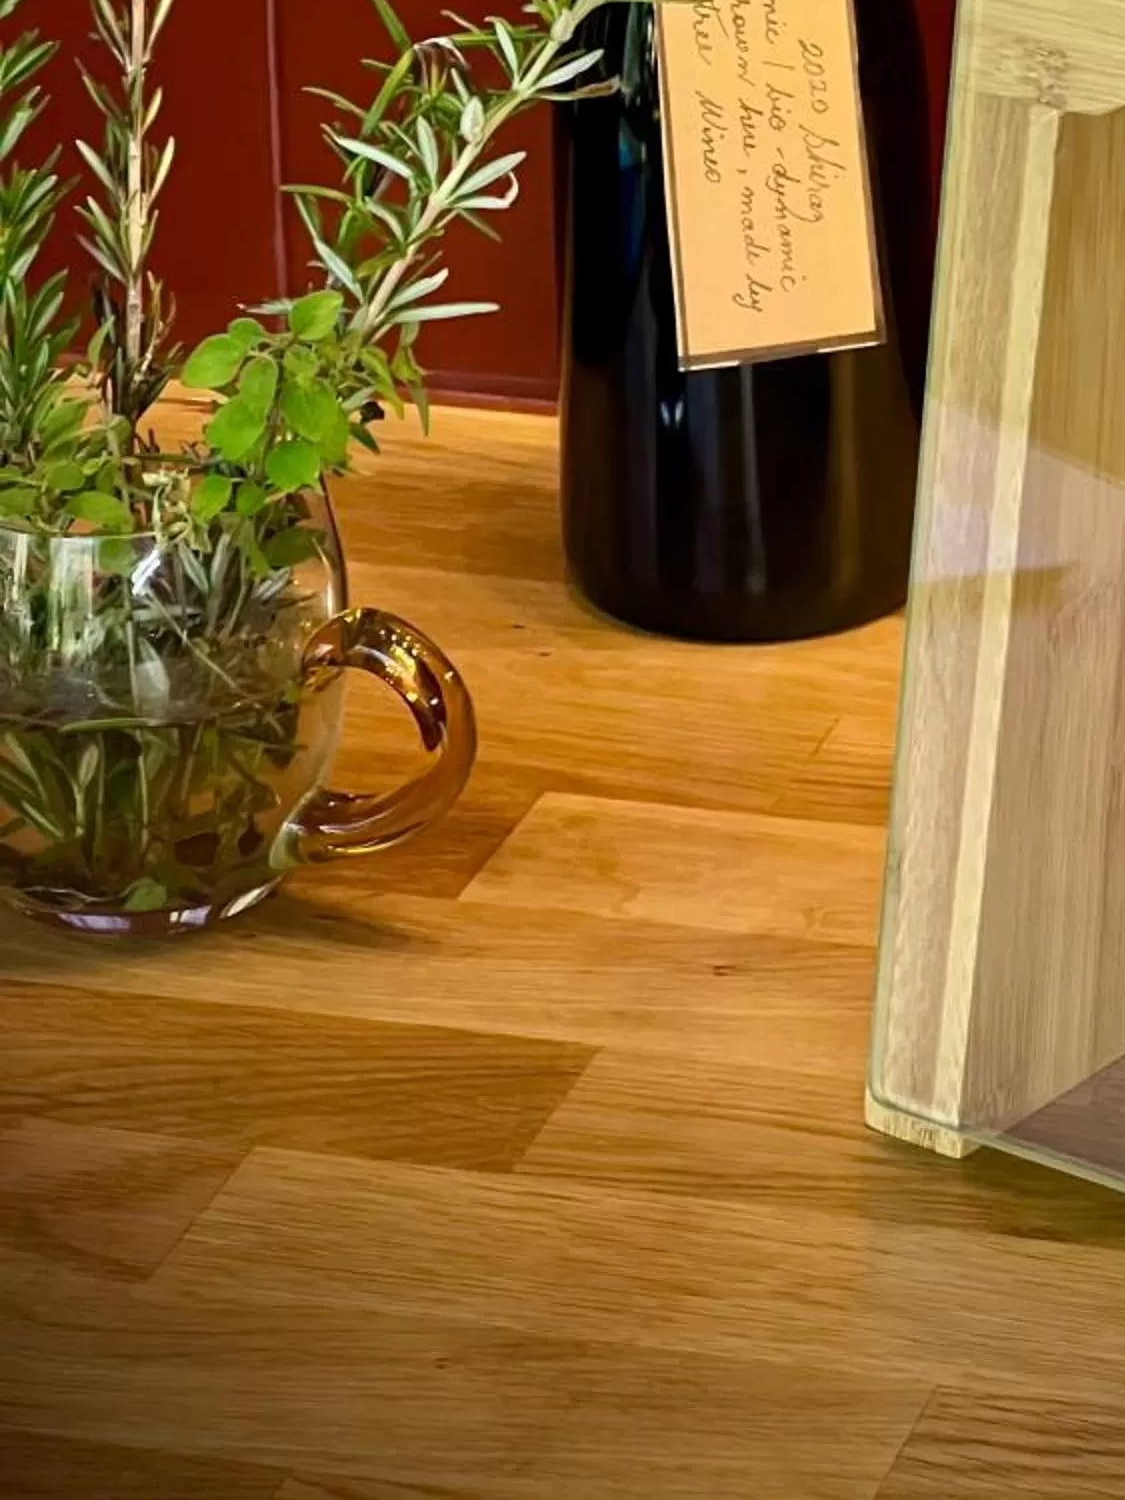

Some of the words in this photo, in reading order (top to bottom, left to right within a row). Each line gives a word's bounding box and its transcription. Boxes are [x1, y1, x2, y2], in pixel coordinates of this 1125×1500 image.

[798, 37, 829, 114] 2020
[694, 90, 729, 184] Wines
[794, 123, 847, 223] Shiraz
[740, 186, 770, 266] made
[731, 273, 773, 313] by
